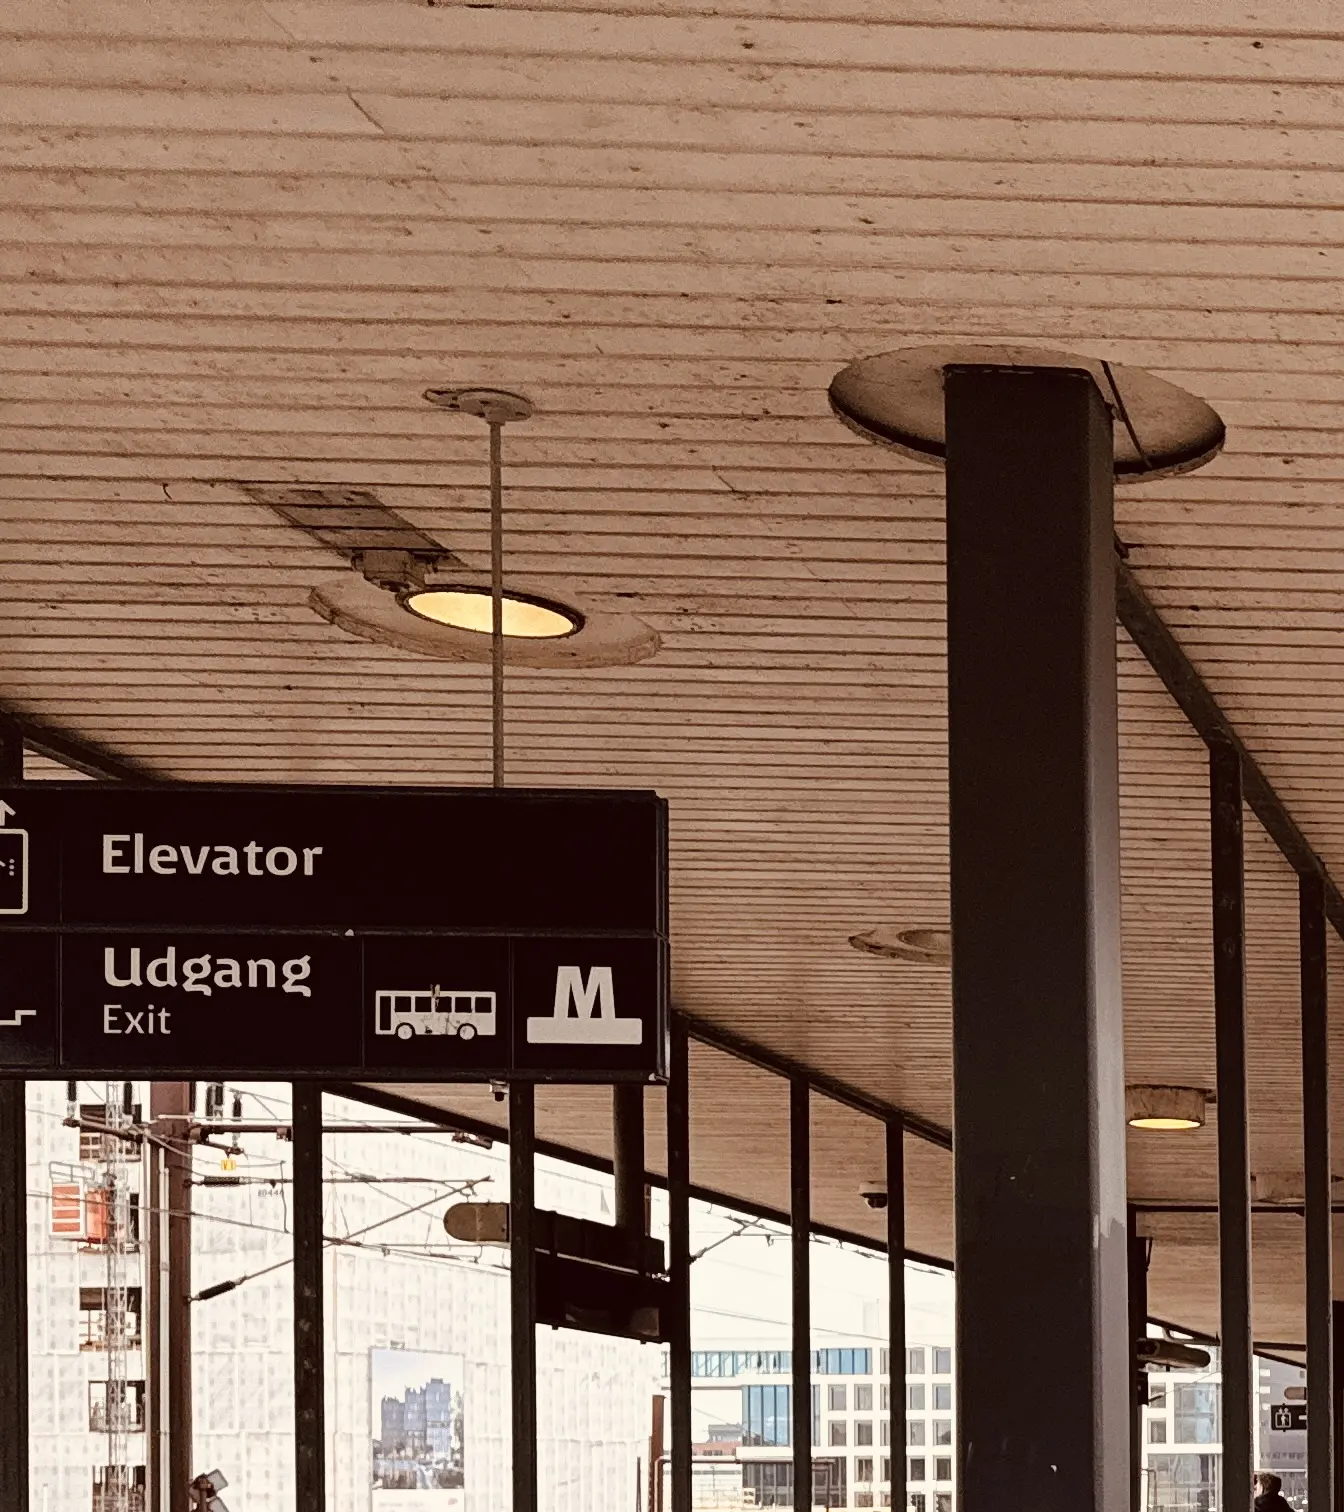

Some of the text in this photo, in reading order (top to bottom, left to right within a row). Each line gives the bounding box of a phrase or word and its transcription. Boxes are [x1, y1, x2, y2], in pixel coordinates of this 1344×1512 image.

[102, 832, 324, 876] Elevator
[103, 946, 312, 998] Udgang
[553, 965, 616, 1018] M
[103, 1004, 172, 1035] Exit
